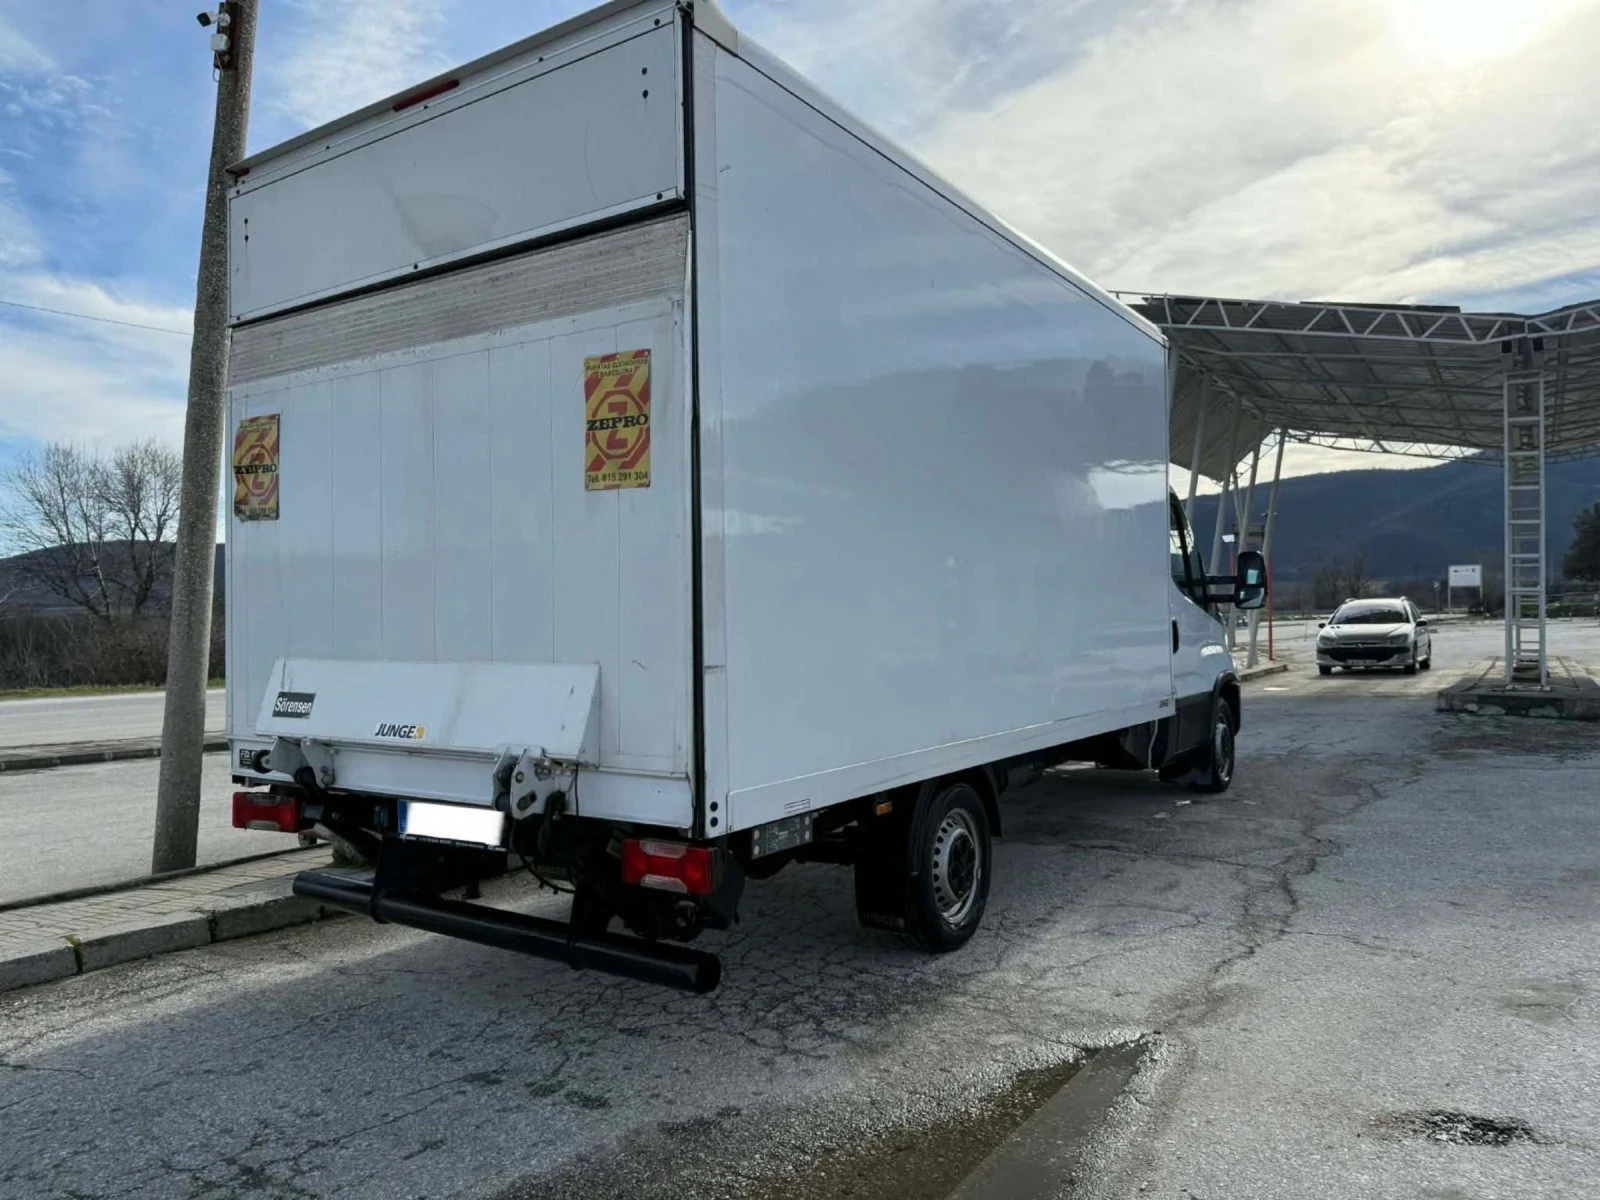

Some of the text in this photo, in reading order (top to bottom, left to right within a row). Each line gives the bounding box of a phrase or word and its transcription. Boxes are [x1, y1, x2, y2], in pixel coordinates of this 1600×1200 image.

[587, 413, 649, 432] ZEPRO
[618, 471, 632, 481] 291
[634, 470, 649, 481] 304
[275, 697, 312, 714] Sörensen
